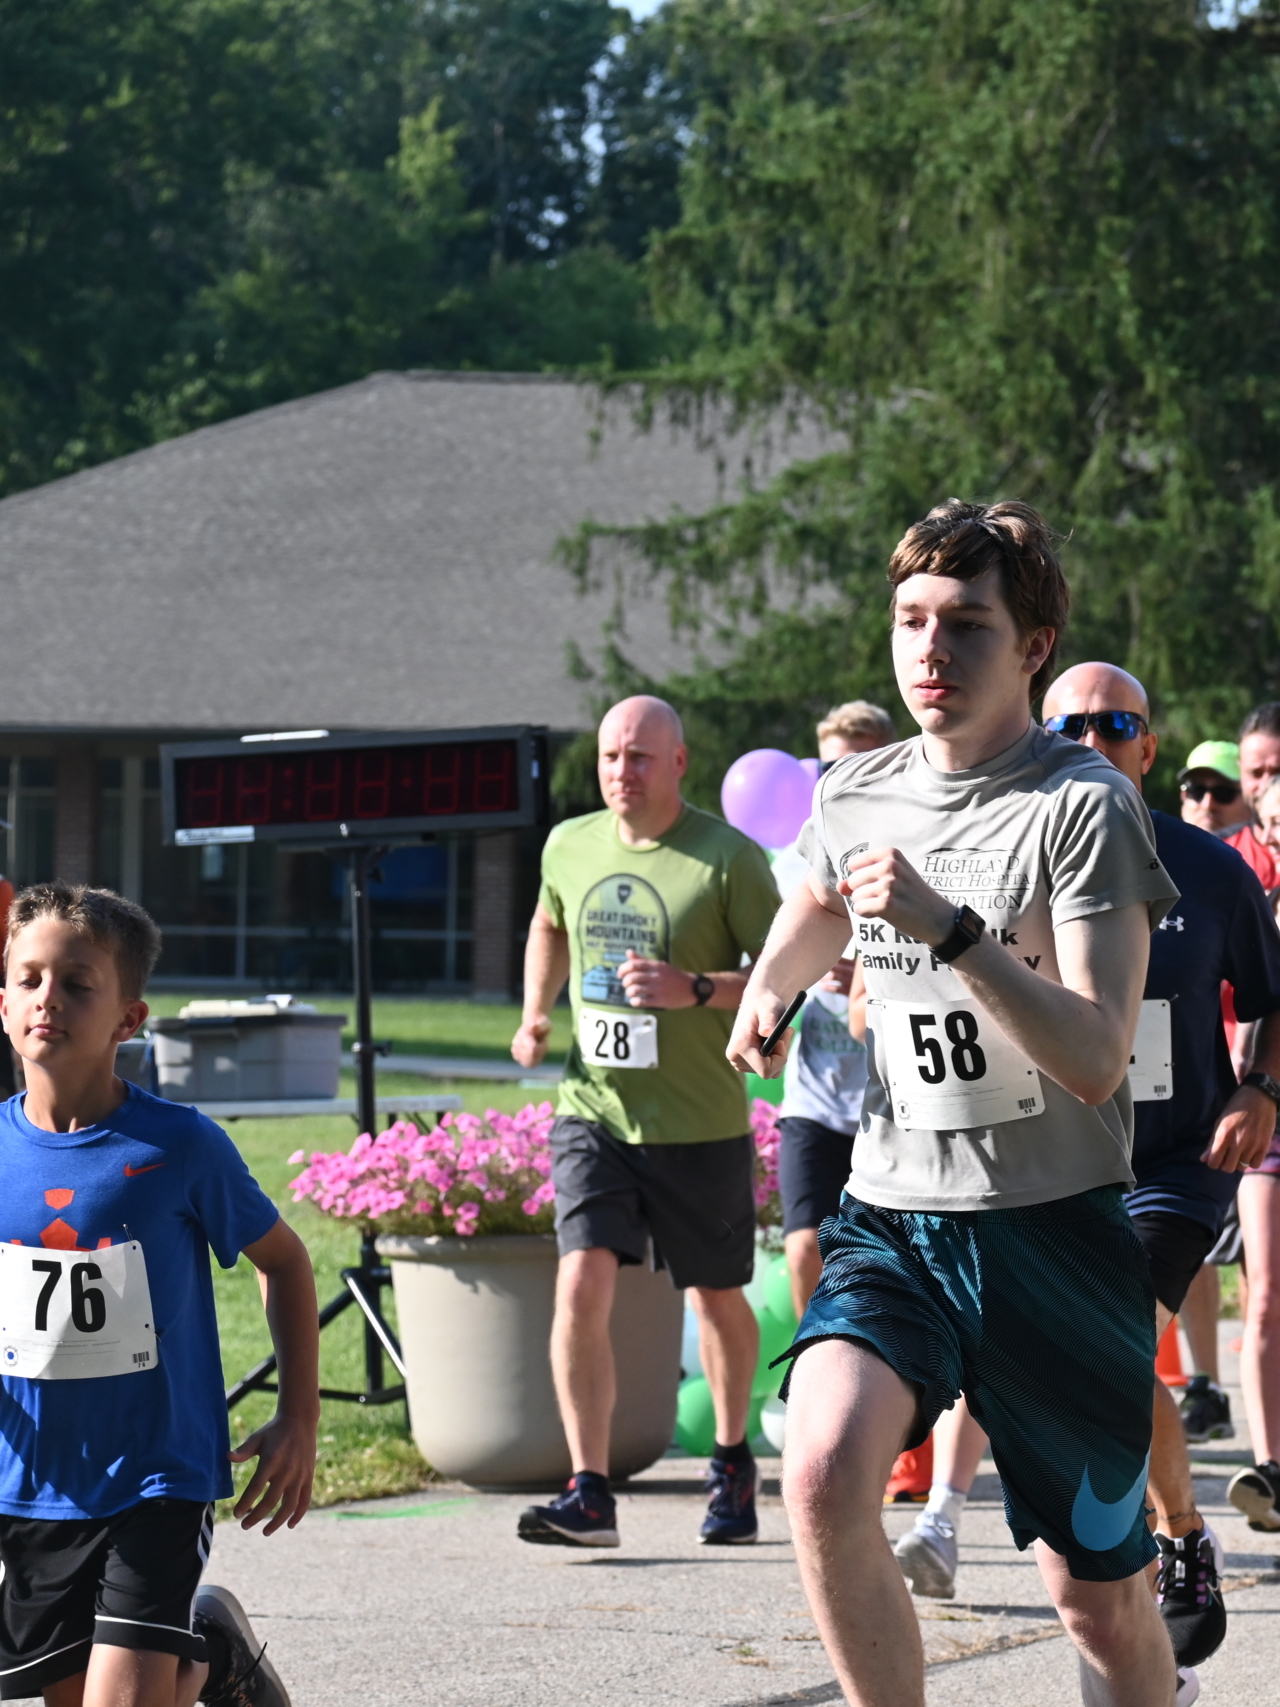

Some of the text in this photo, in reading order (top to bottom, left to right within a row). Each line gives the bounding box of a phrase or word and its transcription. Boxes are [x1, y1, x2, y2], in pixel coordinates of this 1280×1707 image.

[922, 874, 966, 888] TRICT
[587, 910, 618, 923] GREAT
[586, 925, 657, 944] MOUNTAINS
[859, 923, 885, 942] 5K
[860, 950, 921, 976] amily
[595, 1019, 630, 1060] 28
[908, 1010, 987, 1084] 58
[32, 1259, 107, 1333] 76
